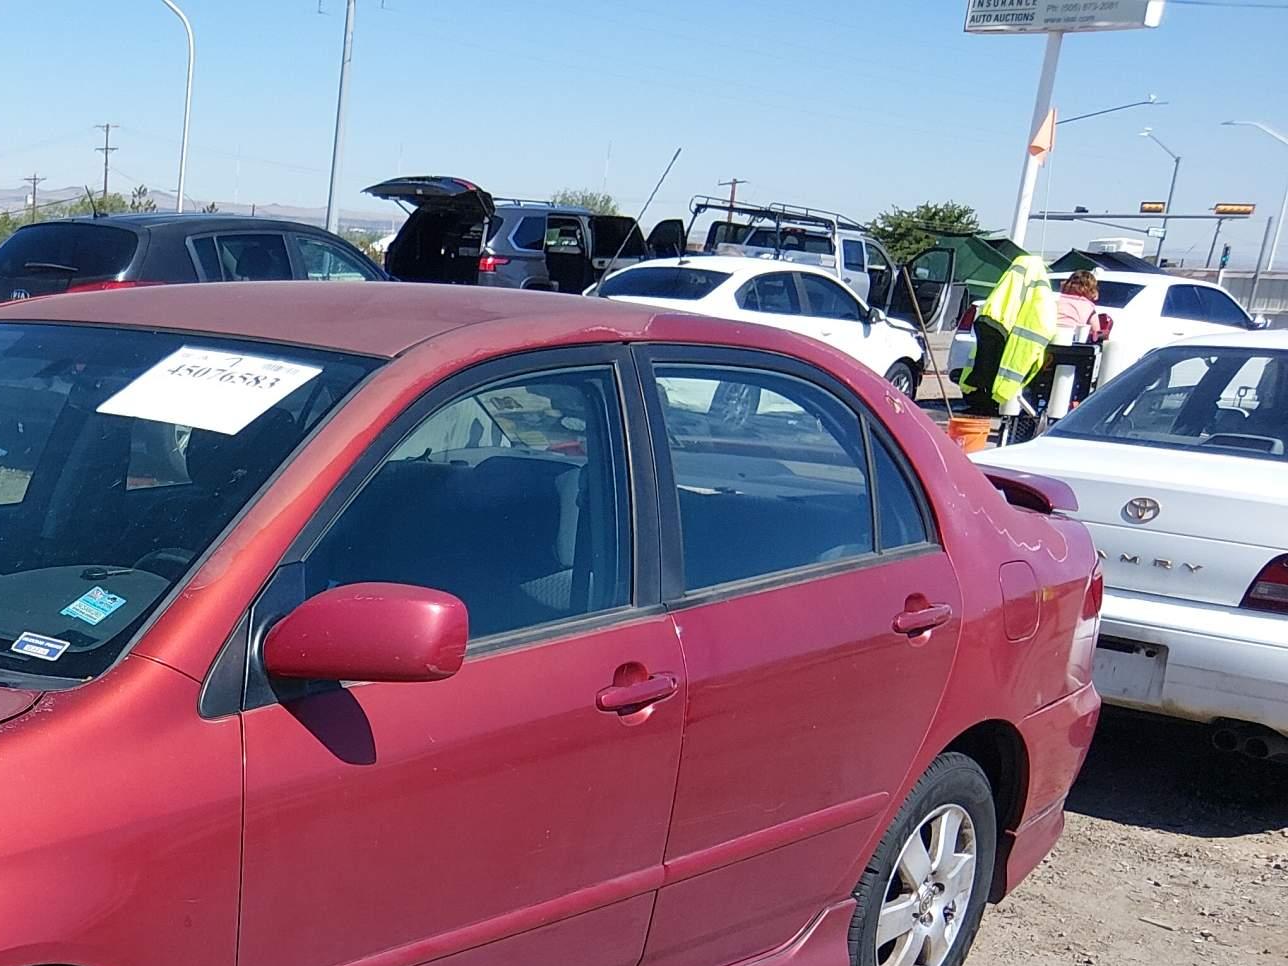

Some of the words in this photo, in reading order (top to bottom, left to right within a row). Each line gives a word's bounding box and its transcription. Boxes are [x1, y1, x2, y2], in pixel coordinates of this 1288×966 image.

[972, 0, 1038, 8] INSURANCE
[969, 13, 992, 24] AUTO
[993, 12, 1036, 23] AUCTIONS
[167, 363, 281, 389] 45076583
